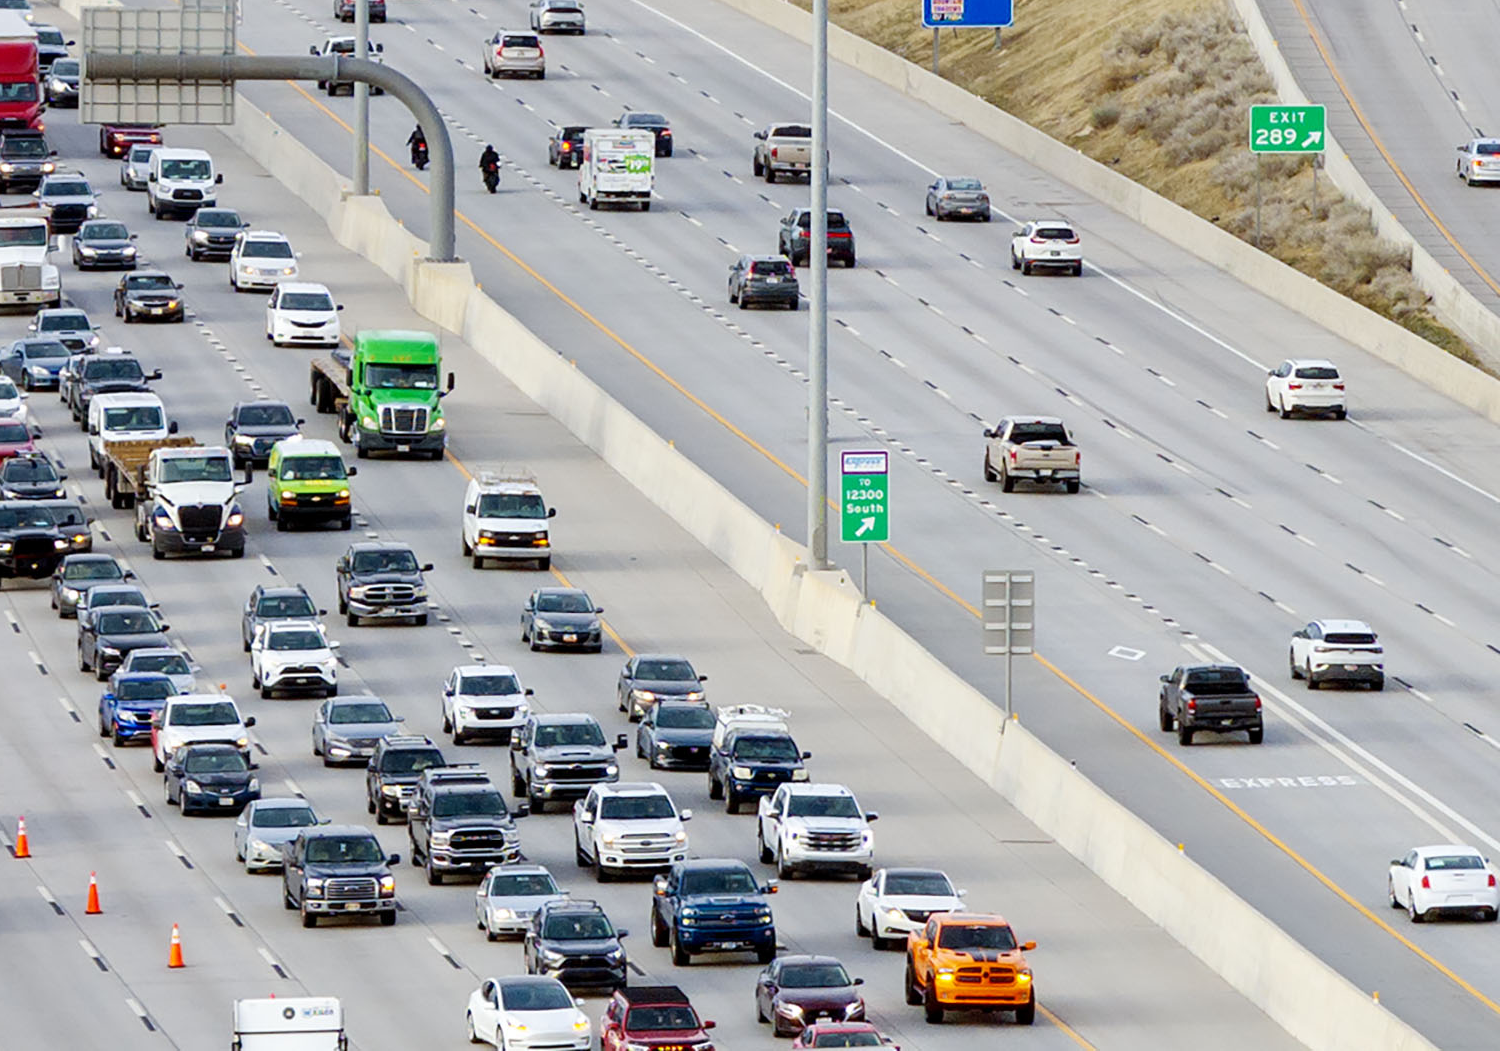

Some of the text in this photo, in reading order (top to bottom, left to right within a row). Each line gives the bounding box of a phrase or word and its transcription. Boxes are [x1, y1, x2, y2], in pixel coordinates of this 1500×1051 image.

[1269, 111, 1306, 123] EXIT
[1255, 128, 1297, 145] 289
[858, 478, 871, 486] TO
[846, 489, 884, 500] 12300
[846, 503, 884, 514] South
[1219, 775, 1357, 789] EXPRESS
